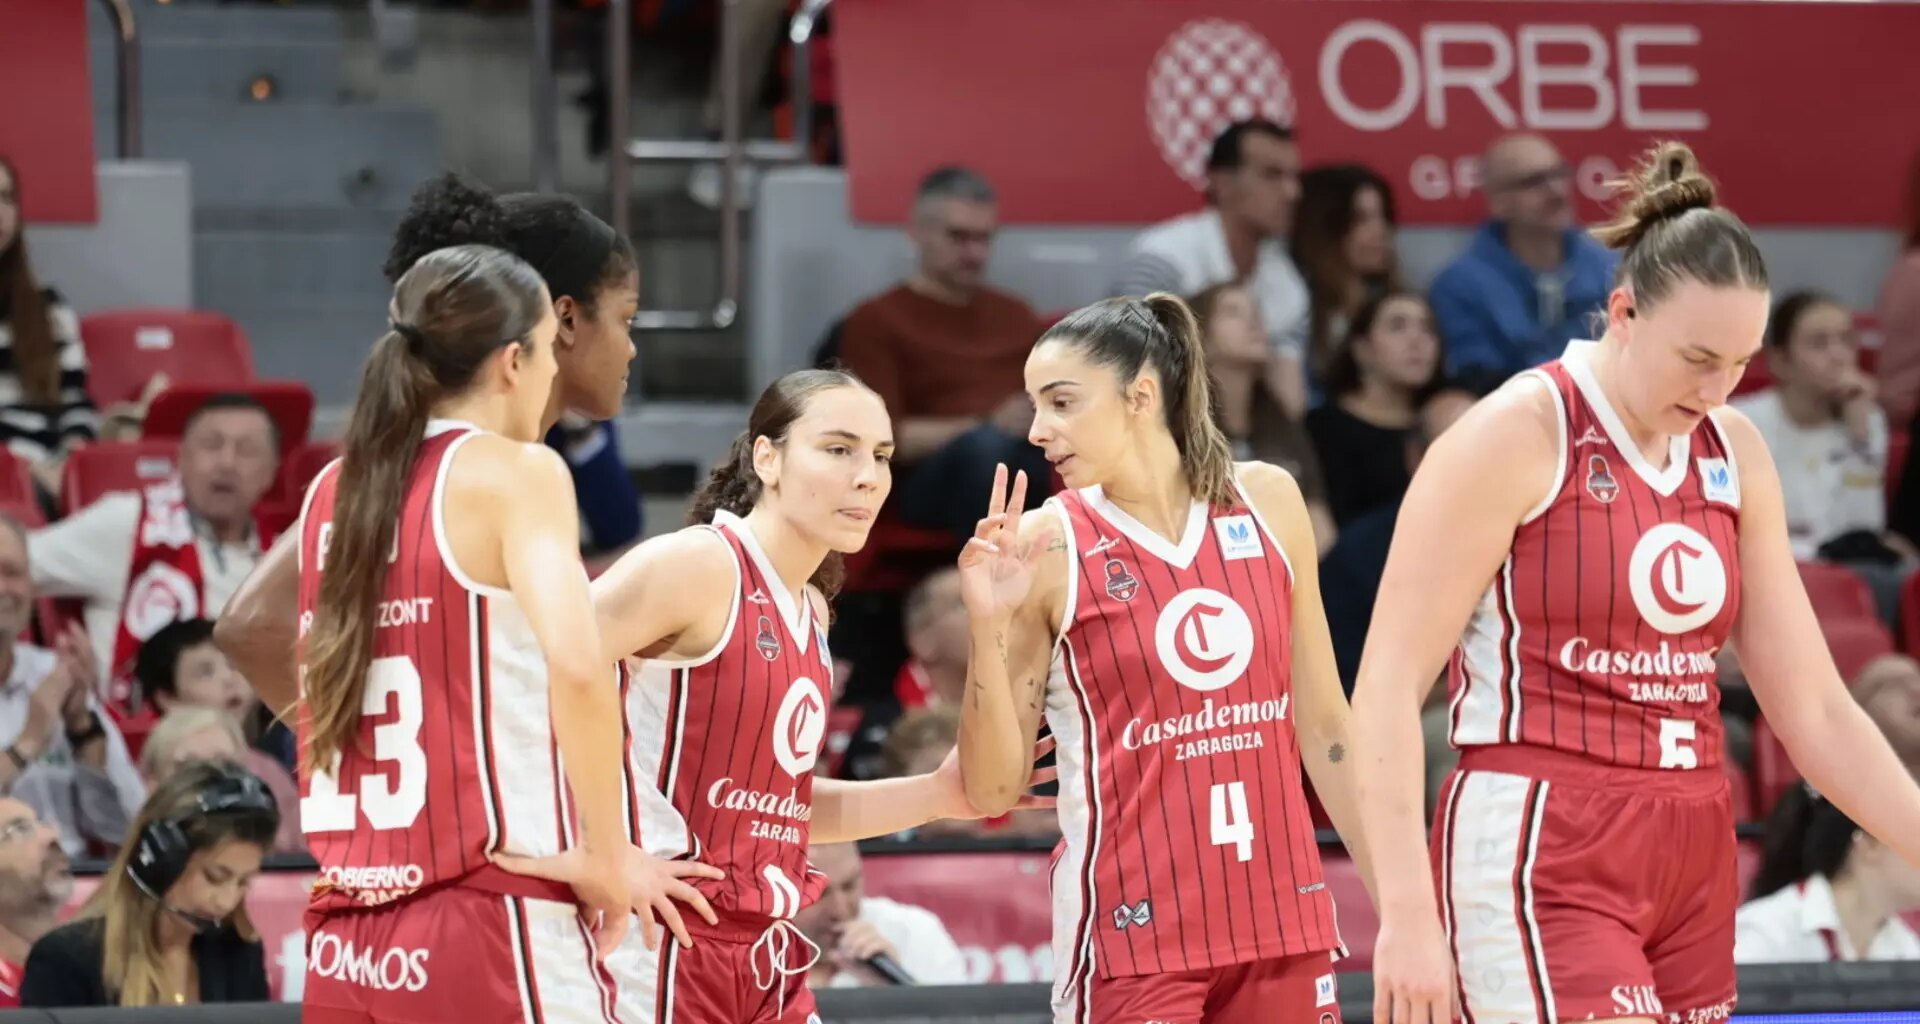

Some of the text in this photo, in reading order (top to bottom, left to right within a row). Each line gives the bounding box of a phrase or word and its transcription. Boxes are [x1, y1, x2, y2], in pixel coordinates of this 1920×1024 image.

[1318, 19, 1708, 131] ORBE
[1175, 731, 1264, 761] ZARAGOZA
[1659, 718, 1698, 769] 5
[1210, 781, 1254, 862] 4
